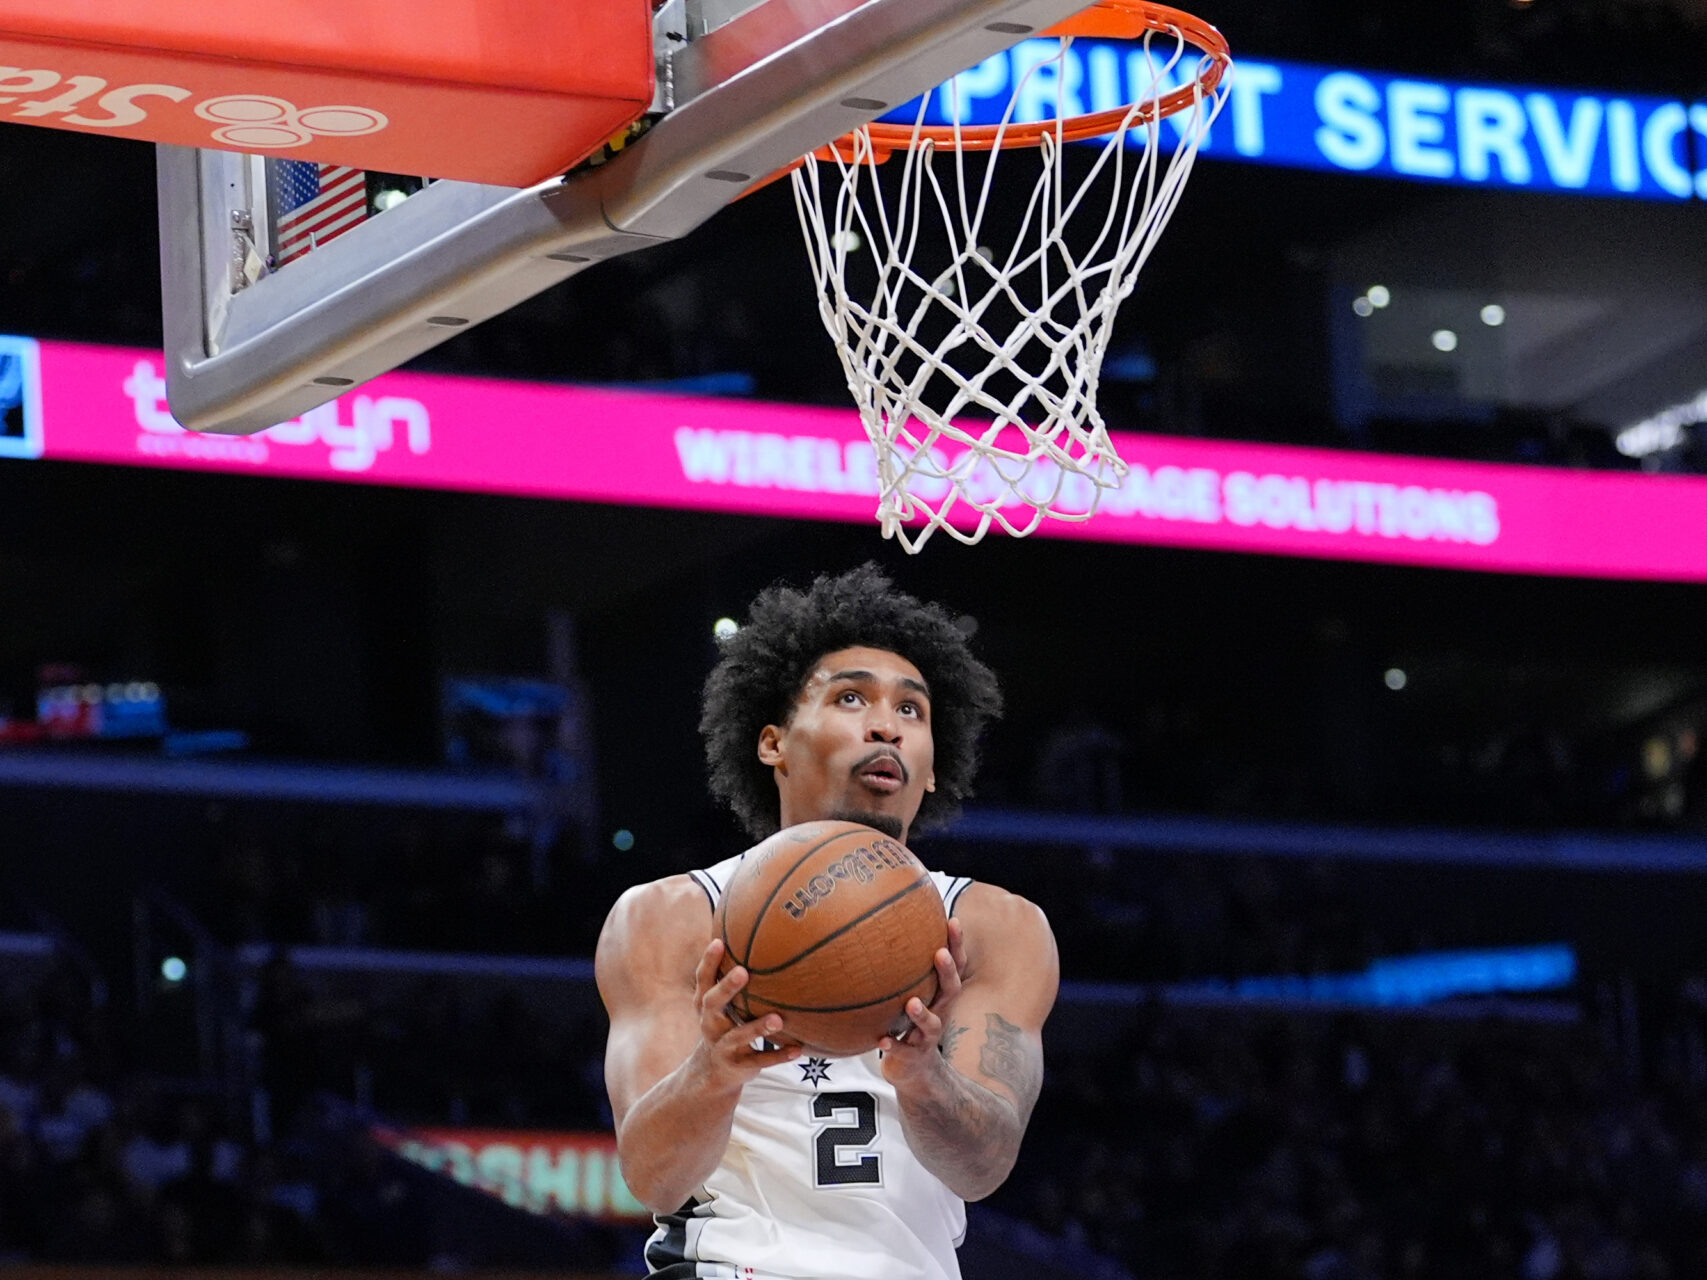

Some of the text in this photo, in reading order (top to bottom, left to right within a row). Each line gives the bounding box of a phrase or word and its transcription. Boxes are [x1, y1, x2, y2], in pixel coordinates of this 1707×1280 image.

[939, 36, 1707, 199] PRINT SERVIC
[1222, 471, 1499, 545] SOLUTIONS
[808, 1090, 884, 1189] 2
